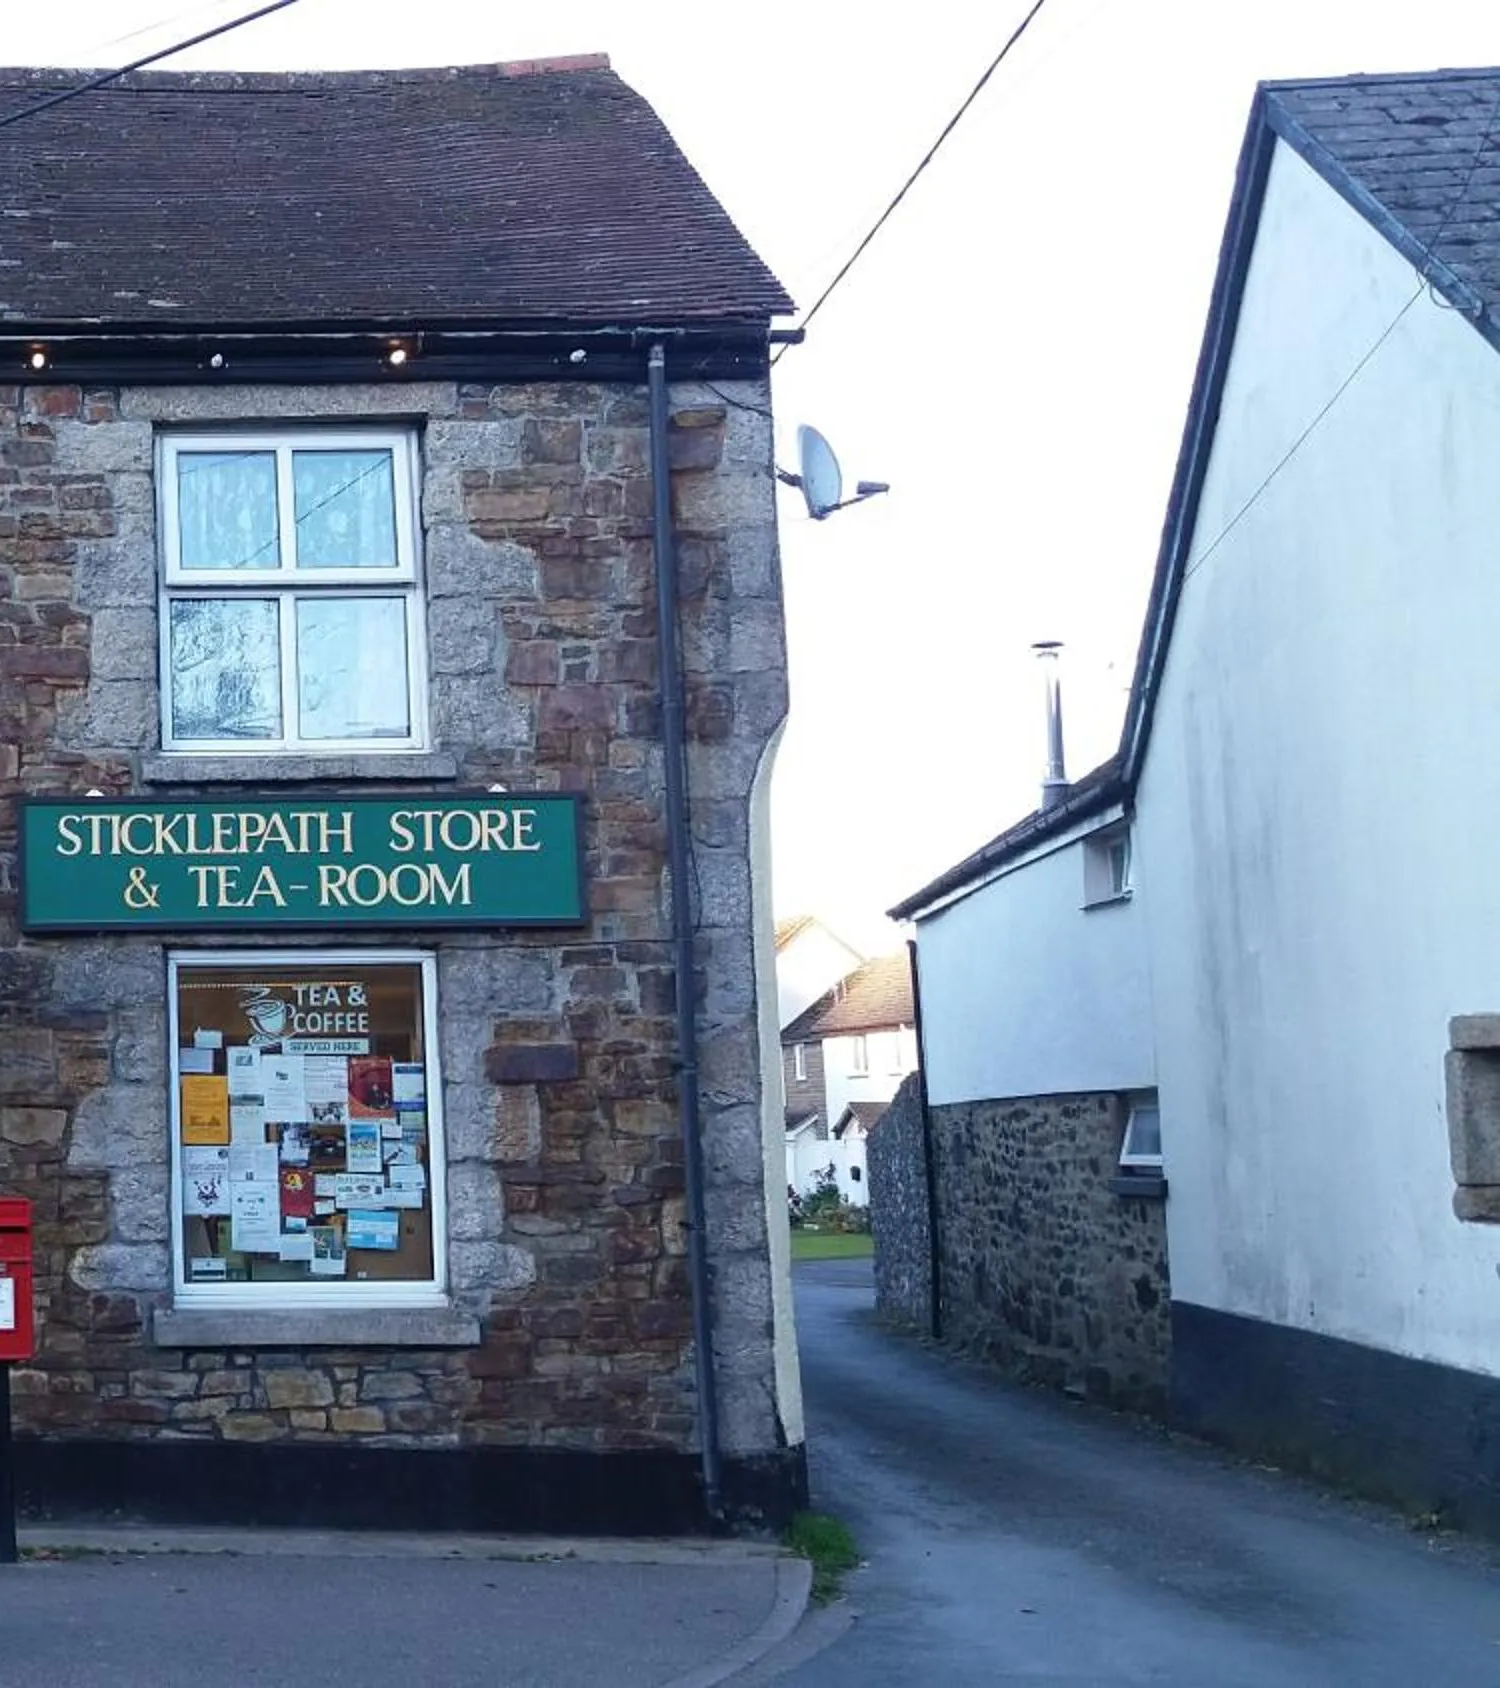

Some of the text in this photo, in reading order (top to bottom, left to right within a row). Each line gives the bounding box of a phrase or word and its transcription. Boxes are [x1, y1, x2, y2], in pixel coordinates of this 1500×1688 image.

[56, 809, 542, 856] STICKLEPATH STORE
[124, 863, 473, 909] & TEA-ROOM
[292, 985, 368, 1007] TEA &
[293, 1012, 369, 1033] COFFEE
[290, 1041, 361, 1052] SERVED HERE
